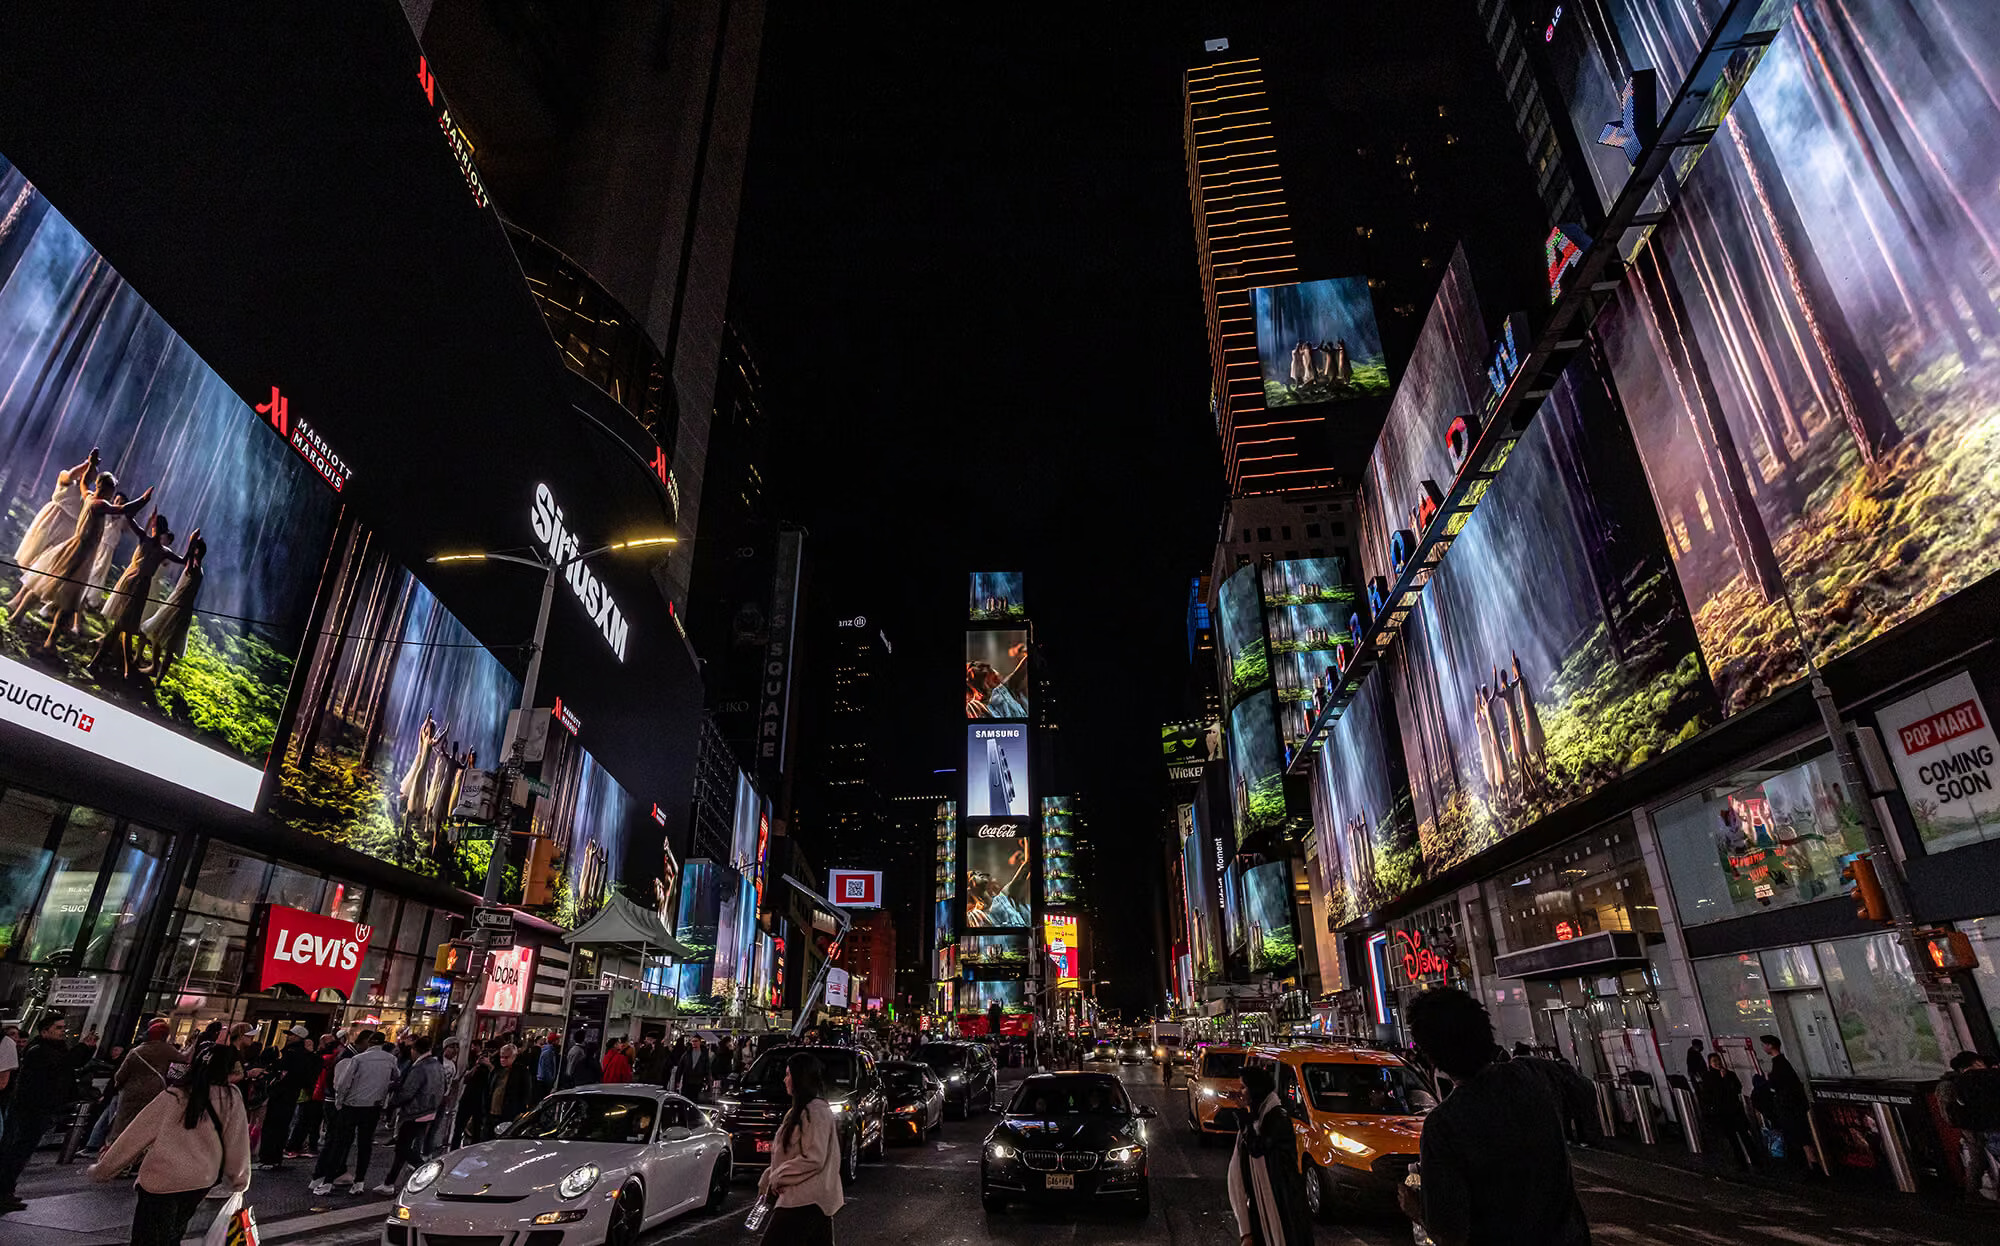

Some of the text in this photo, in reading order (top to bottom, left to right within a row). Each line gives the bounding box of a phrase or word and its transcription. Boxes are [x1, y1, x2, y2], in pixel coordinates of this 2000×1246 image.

[442, 109, 489, 208] MARRIOTT
[293, 432, 342, 489] MARQUIS
[297, 417, 352, 480] MARRIOTT
[762, 642, 783, 757] SQUARE
[975, 729, 1020, 738] SAMSUNG
[1903, 705, 1978, 752] POP MART
[1918, 745, 1993, 785] COMING
[1936, 771, 1992, 803] SOON
[978, 824, 1018, 838] Coca-Cola
[1214, 837, 1224, 871] Moment
[479, 913, 509, 924] ONE WAY
[1396, 929, 1448, 988] Disney
